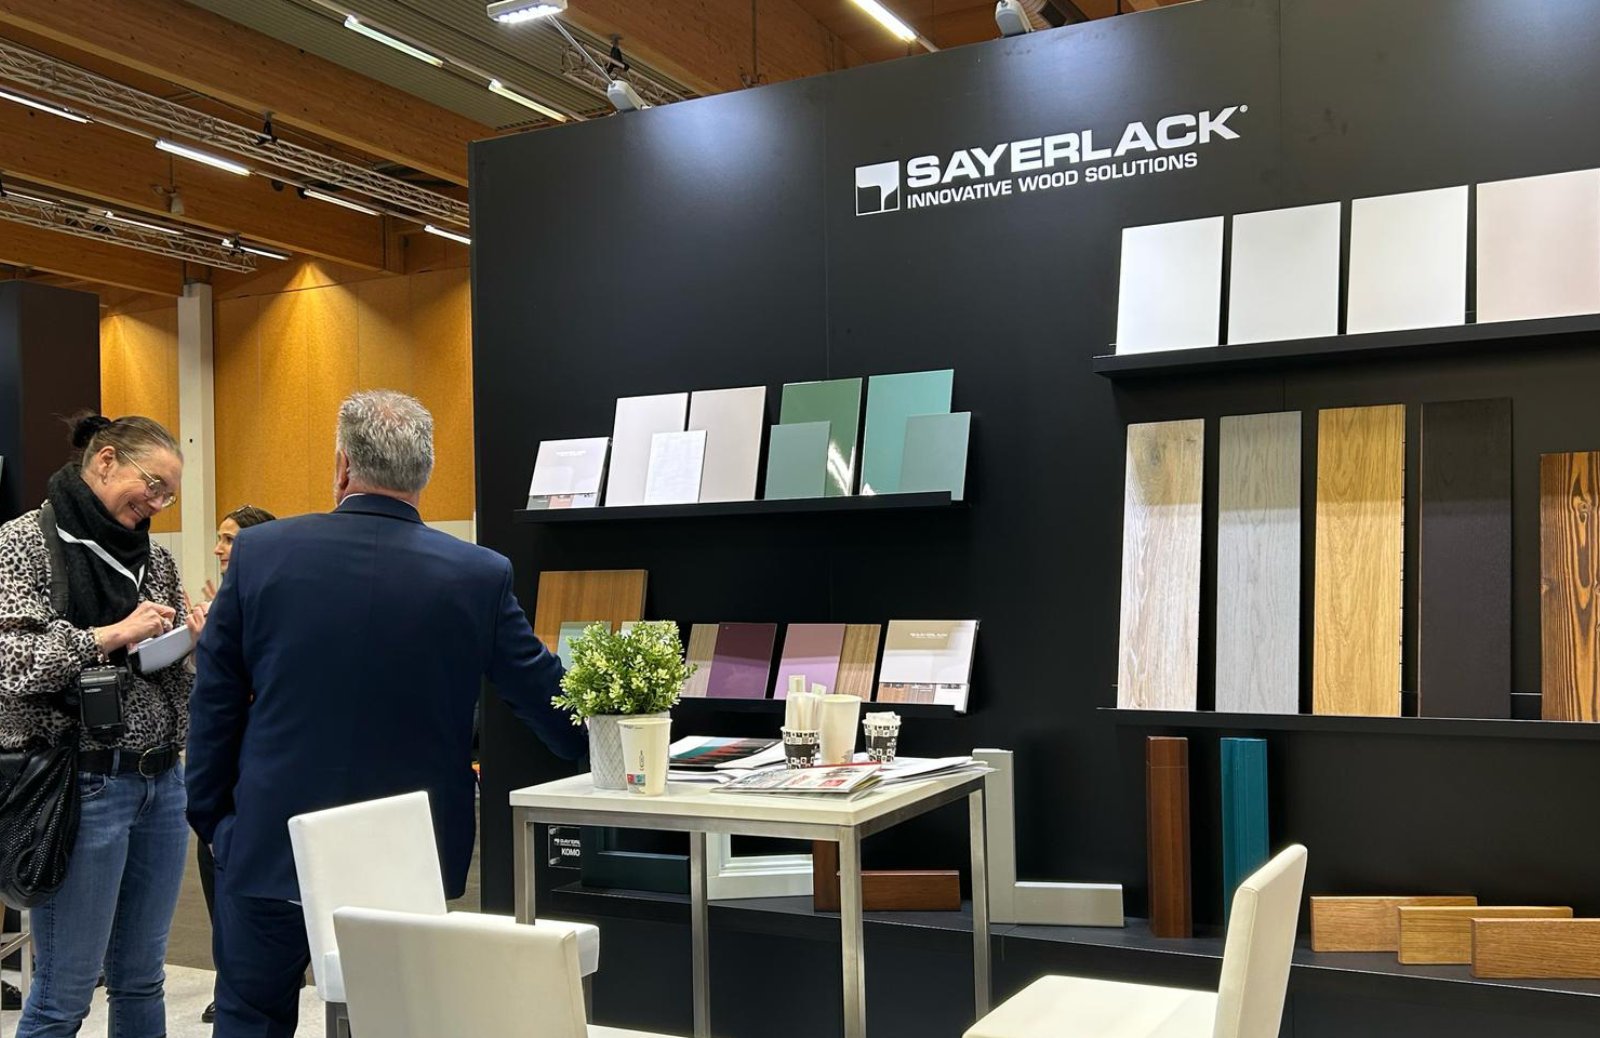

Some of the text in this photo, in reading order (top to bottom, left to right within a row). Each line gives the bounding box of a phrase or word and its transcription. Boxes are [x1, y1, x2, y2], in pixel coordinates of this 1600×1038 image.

[906, 152, 1198, 209] INNOVATIVE WOOD SOLUTIONS
